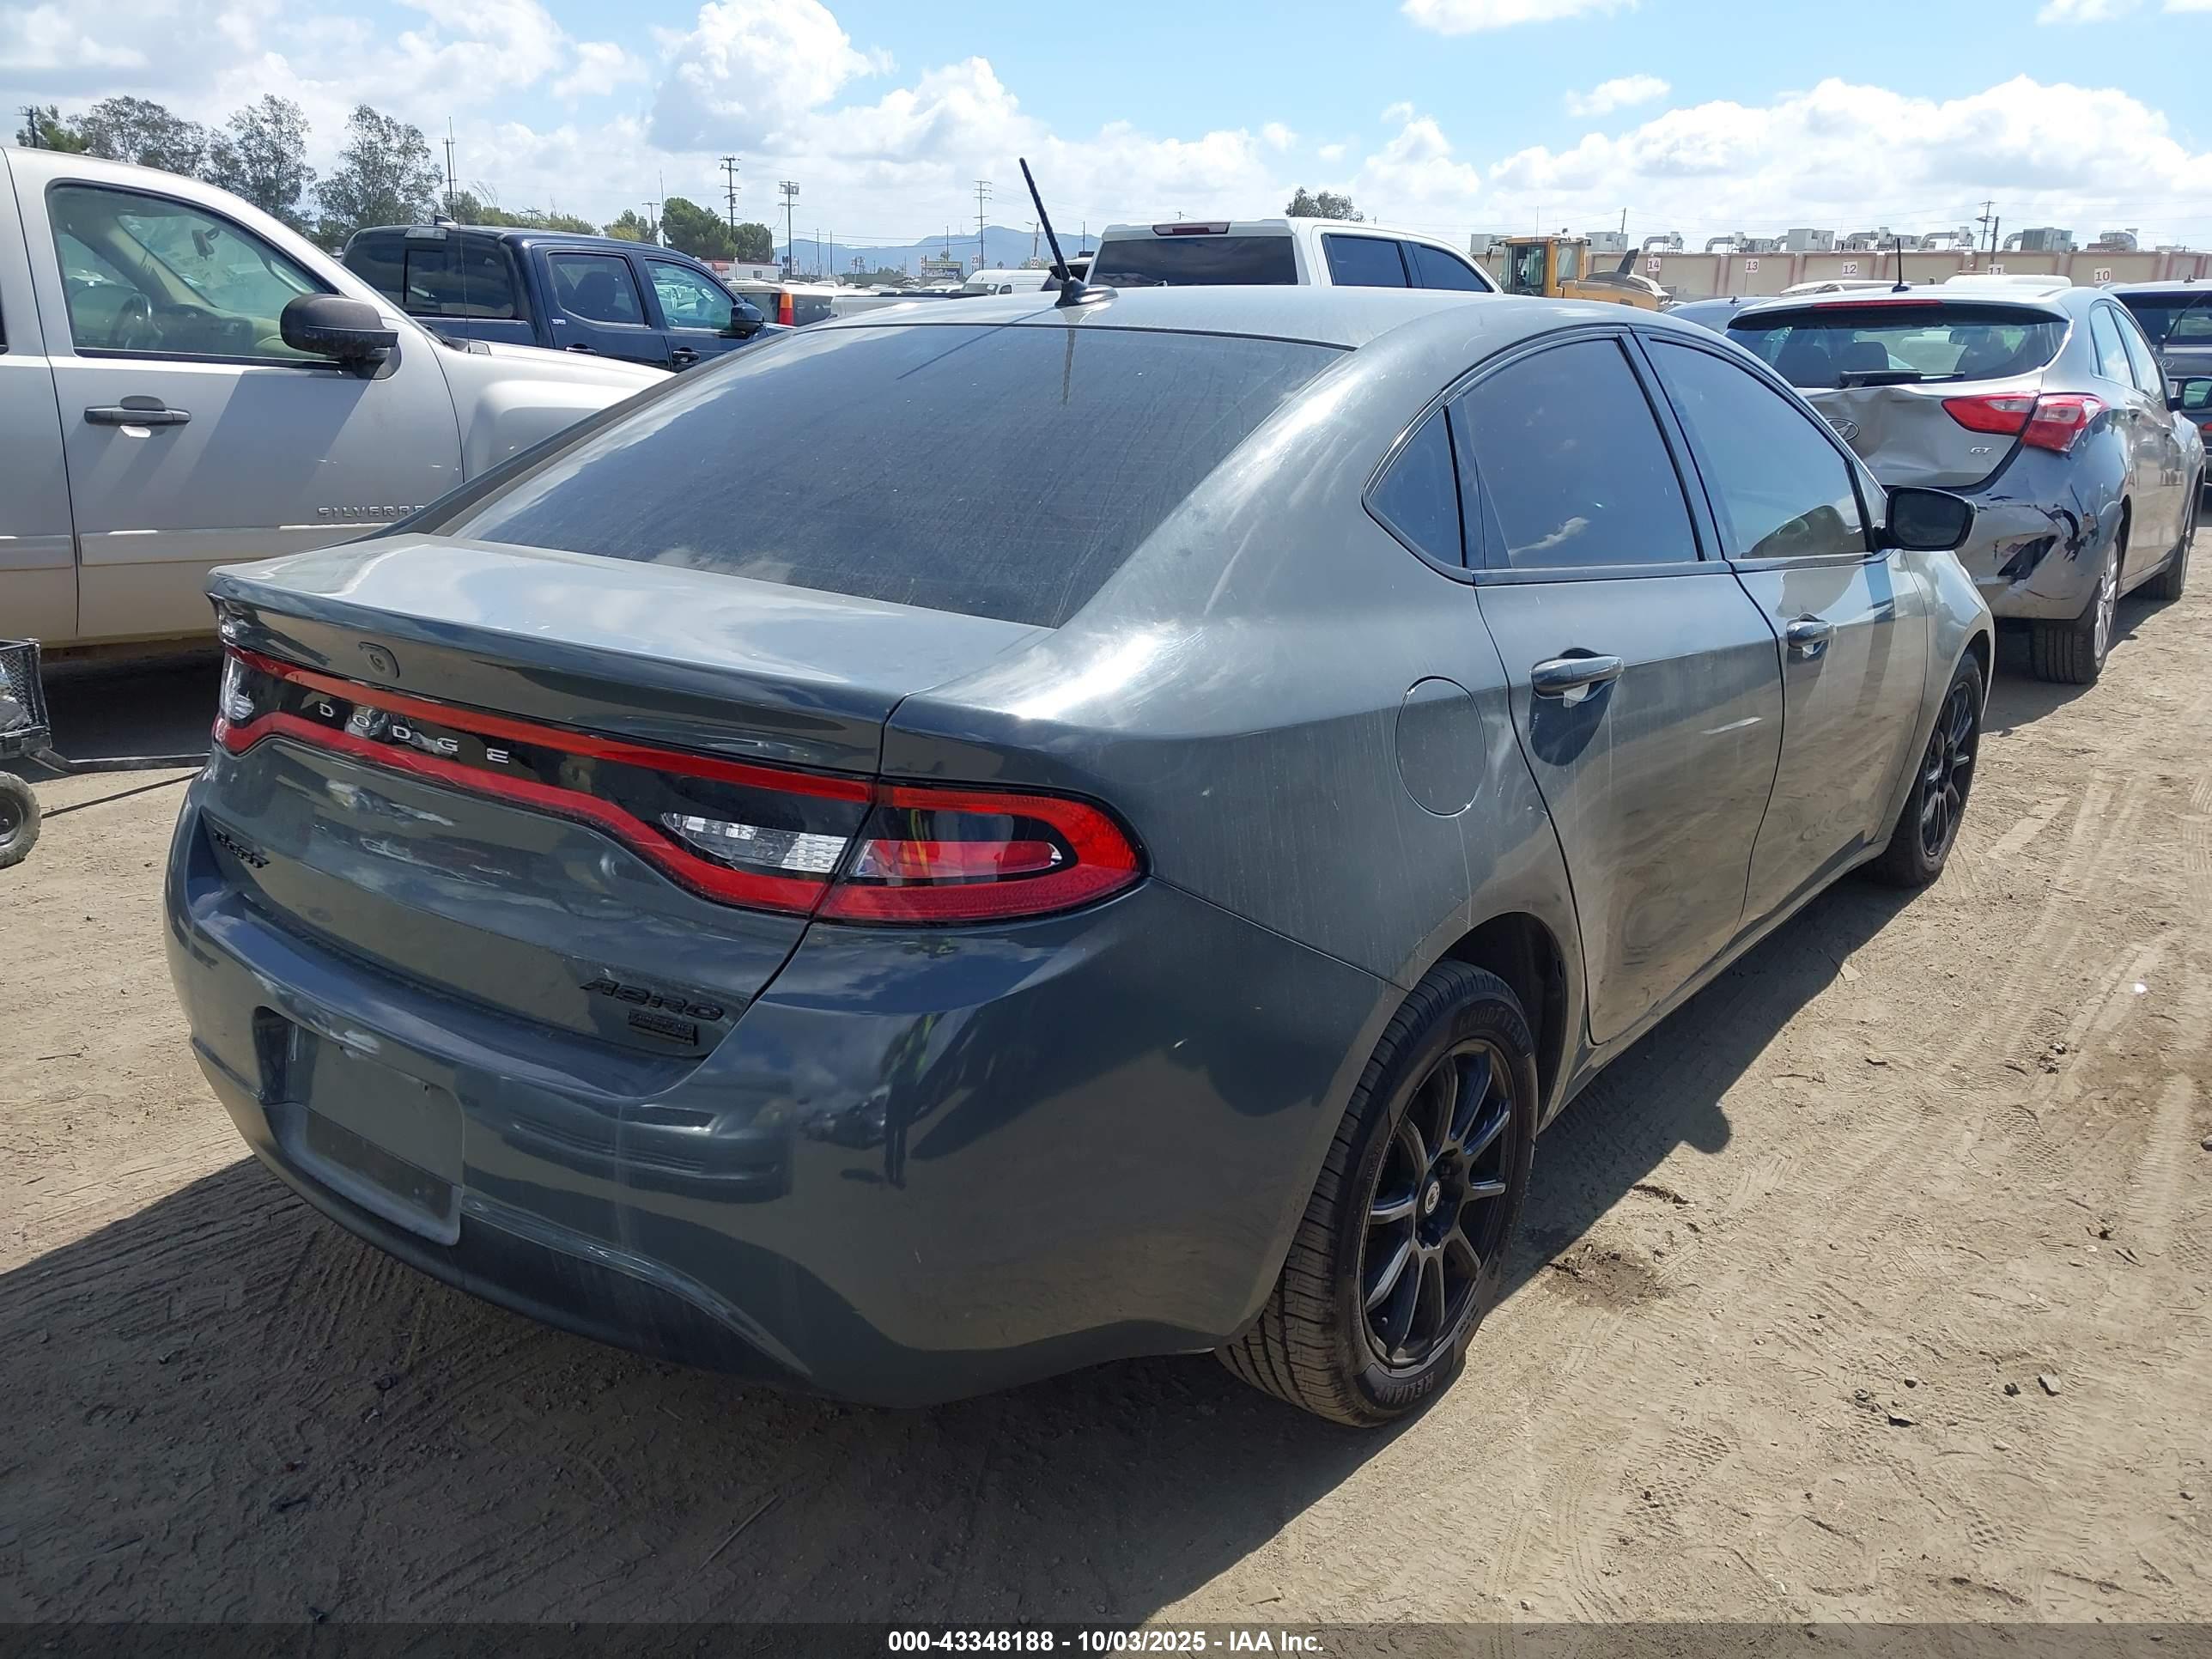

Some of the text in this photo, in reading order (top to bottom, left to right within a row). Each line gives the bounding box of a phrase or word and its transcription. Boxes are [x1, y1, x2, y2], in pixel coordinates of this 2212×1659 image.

[1648, 260, 1660, 270] 14
[1747, 261, 1758, 270] 13
[1844, 264, 1856, 274] 12
[2095, 270, 2110, 281] 10
[319, 702, 509, 764] DODGE
